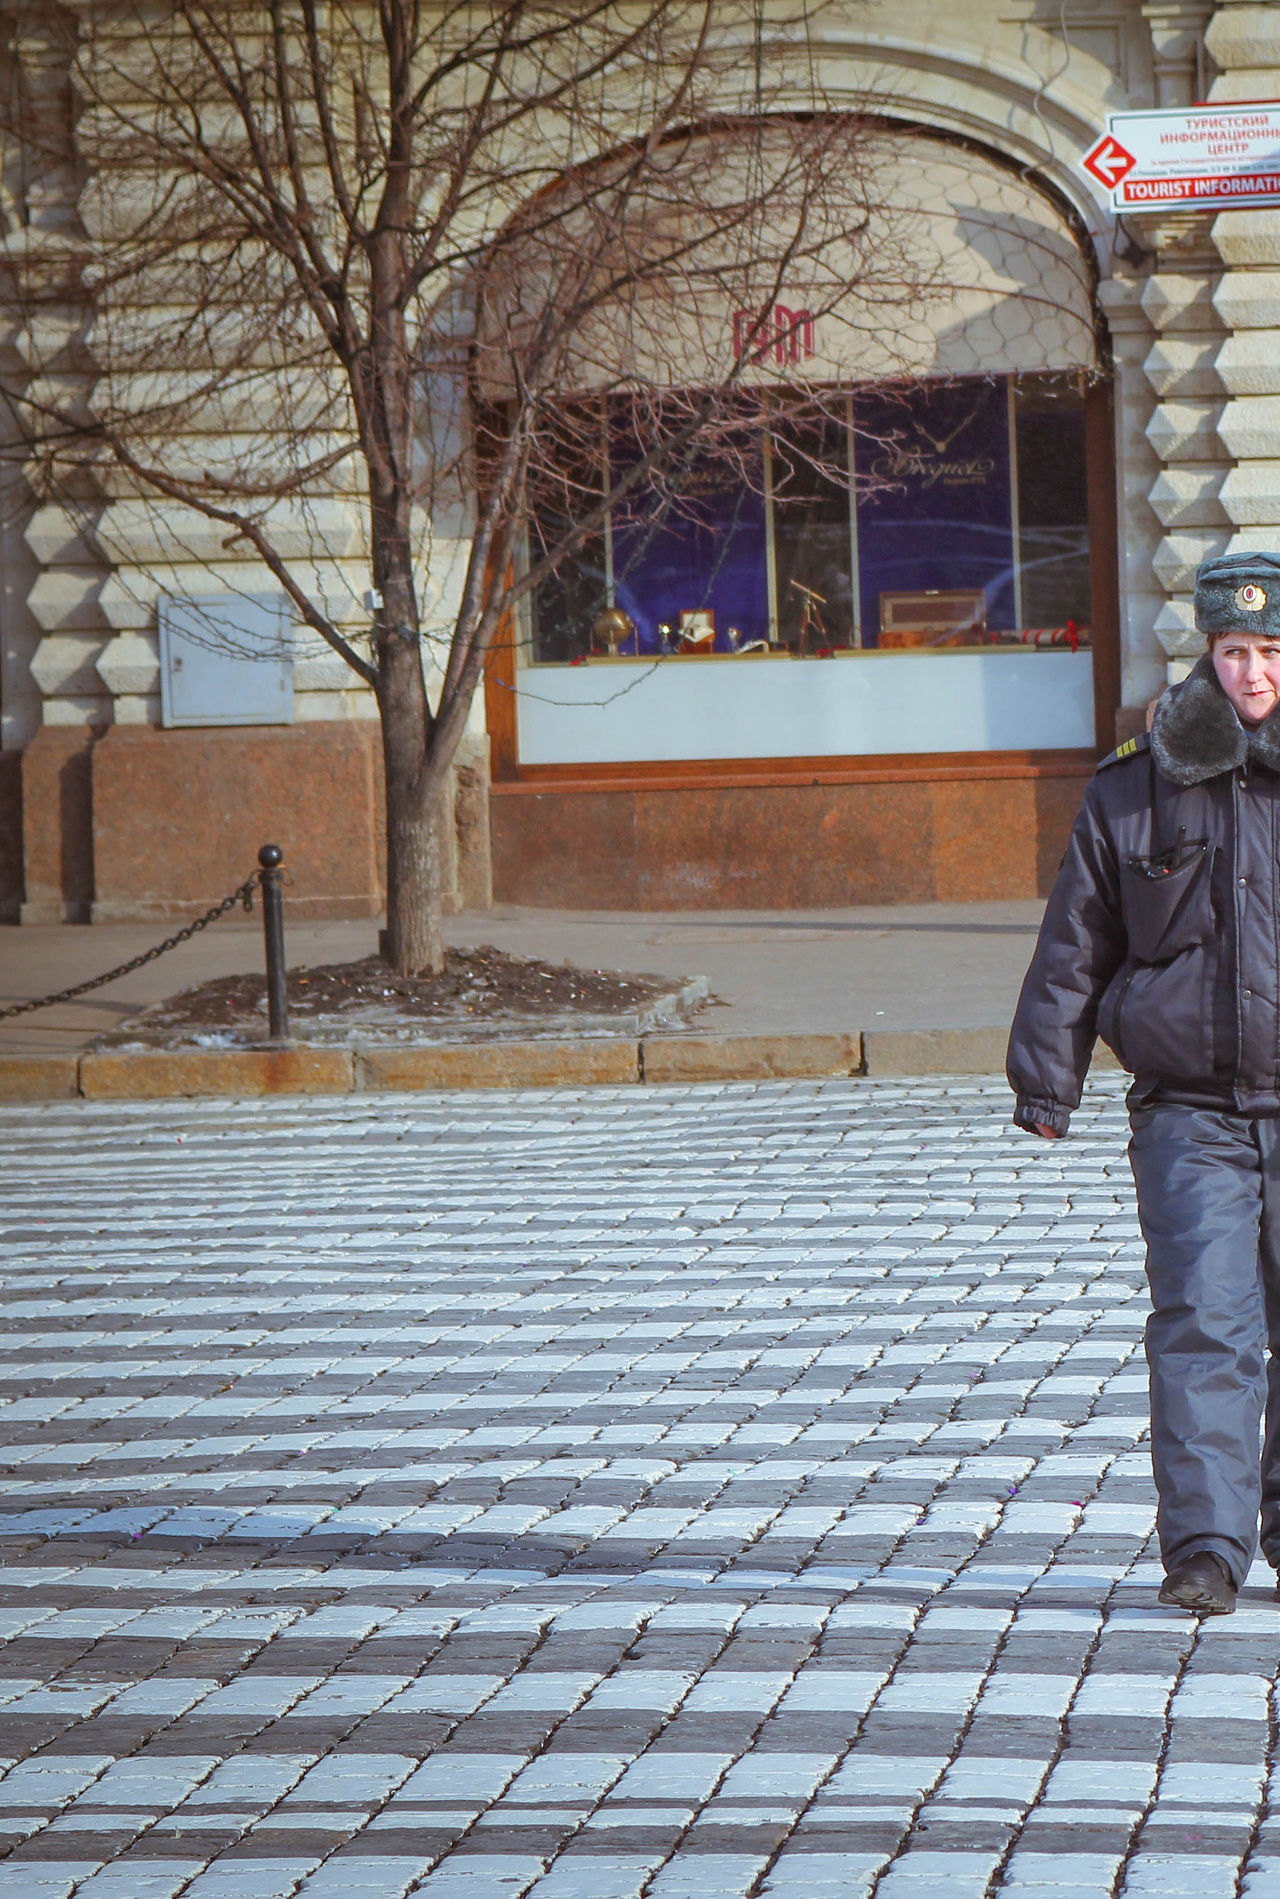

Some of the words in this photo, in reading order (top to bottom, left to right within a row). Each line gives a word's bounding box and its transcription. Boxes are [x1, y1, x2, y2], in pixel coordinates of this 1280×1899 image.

[1185, 114, 1269, 130] ТУРИСТСКИЙ
[1207, 143, 1249, 156] ЦЕНТР
[1126, 182, 1192, 199] TOURIST
